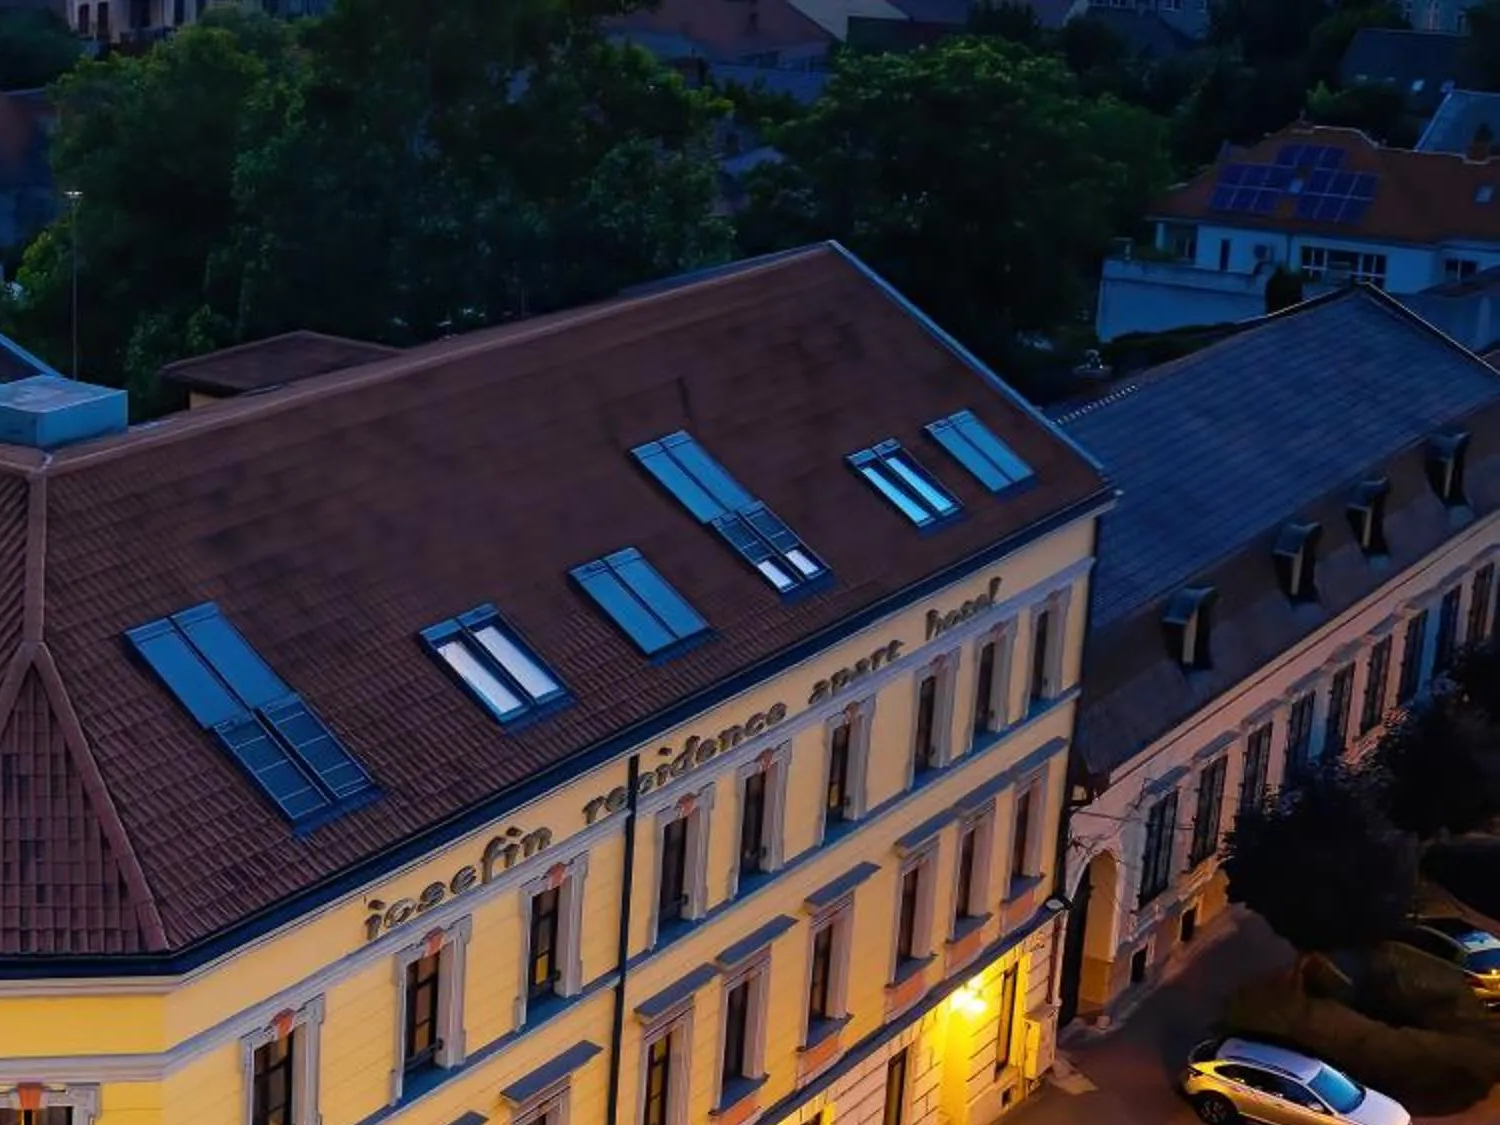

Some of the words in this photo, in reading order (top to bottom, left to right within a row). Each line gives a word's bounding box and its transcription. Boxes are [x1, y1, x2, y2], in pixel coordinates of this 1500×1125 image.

[363, 826, 553, 941] iosefin
[582, 702, 788, 825] residence
[925, 576, 1003, 641] hotel
